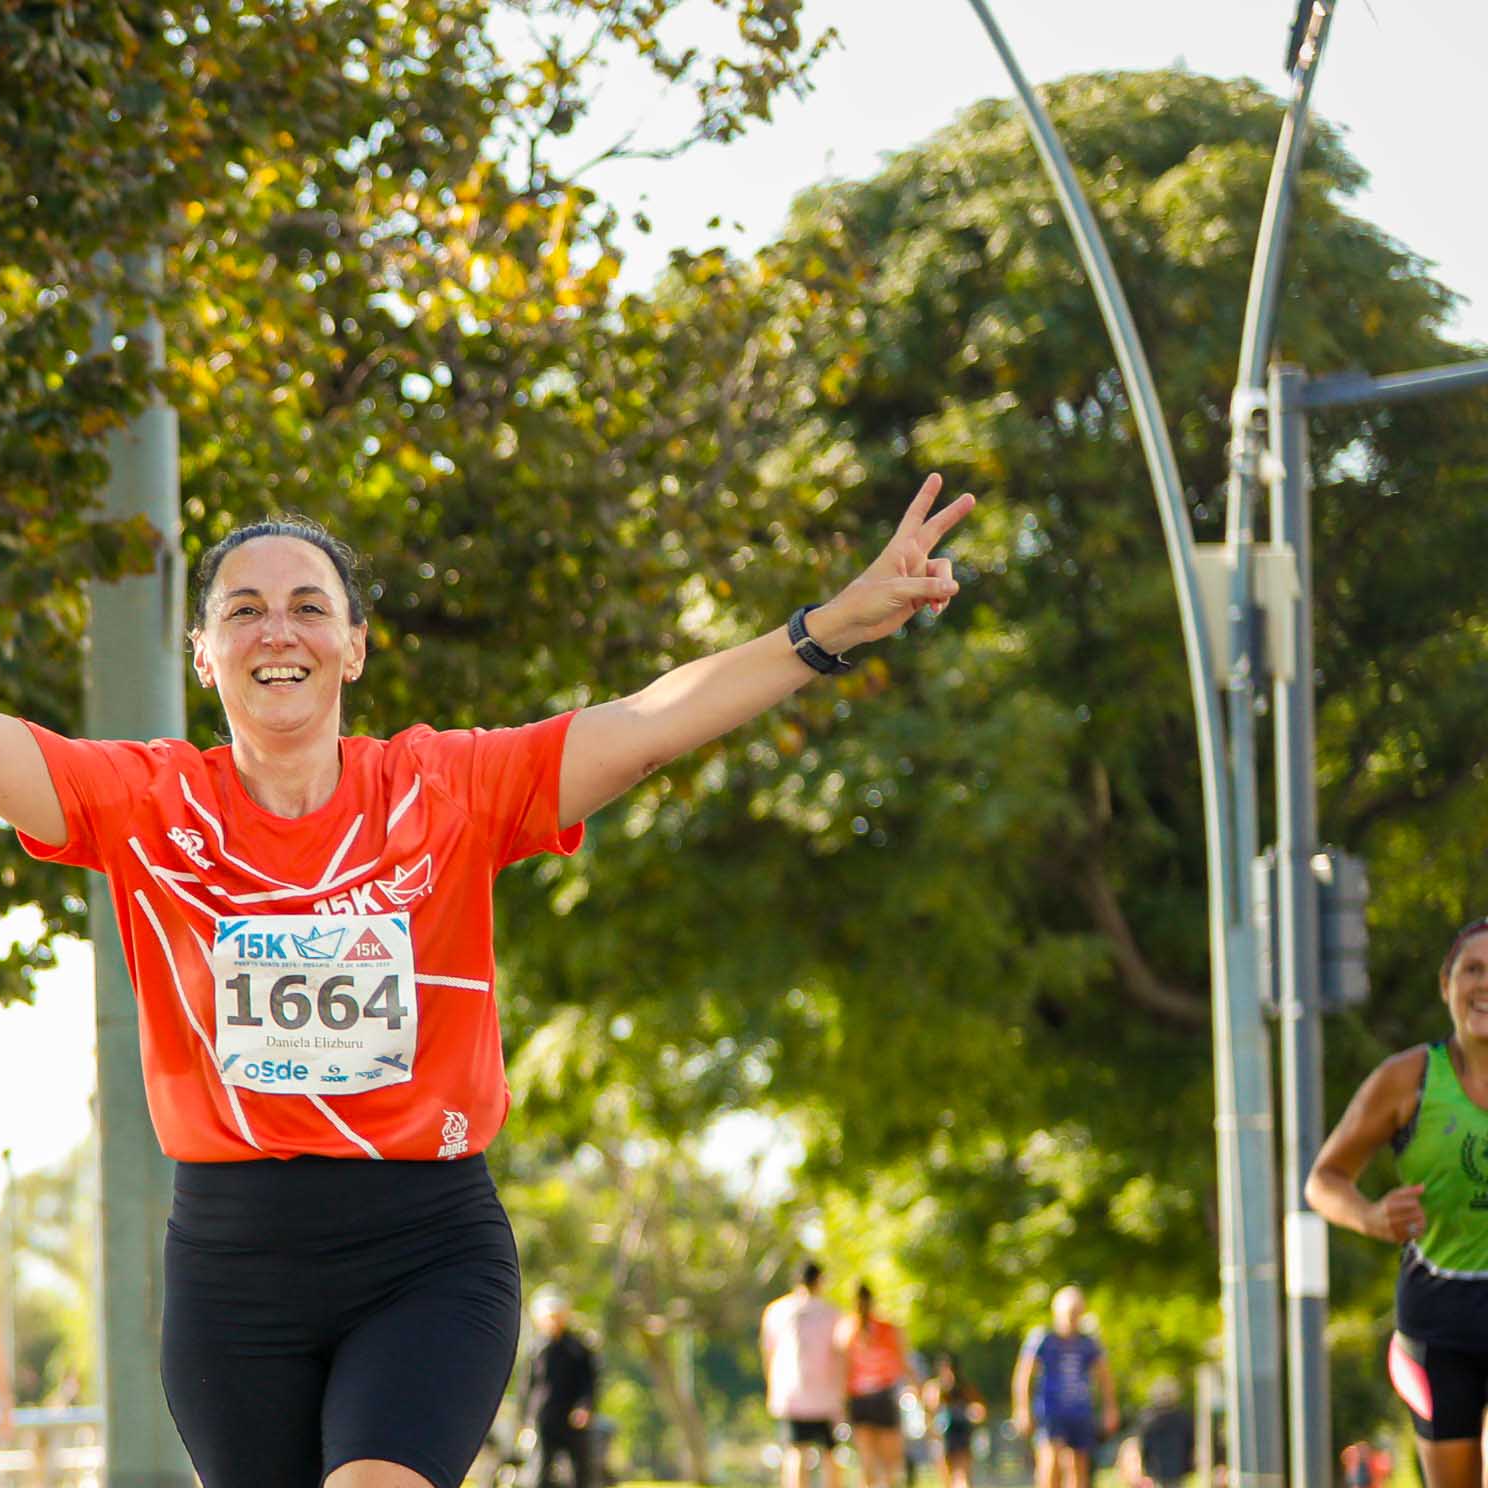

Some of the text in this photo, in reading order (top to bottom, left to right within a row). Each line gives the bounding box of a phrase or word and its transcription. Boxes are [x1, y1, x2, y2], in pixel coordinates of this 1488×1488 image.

[313, 882, 383, 915] 15K
[234, 933, 287, 959] 15K
[355, 943, 382, 957] 15K
[225, 972, 408, 1031] 1664
[266, 1036, 363, 1049] Daniela Elizburu
[244, 1059, 309, 1083] osde
